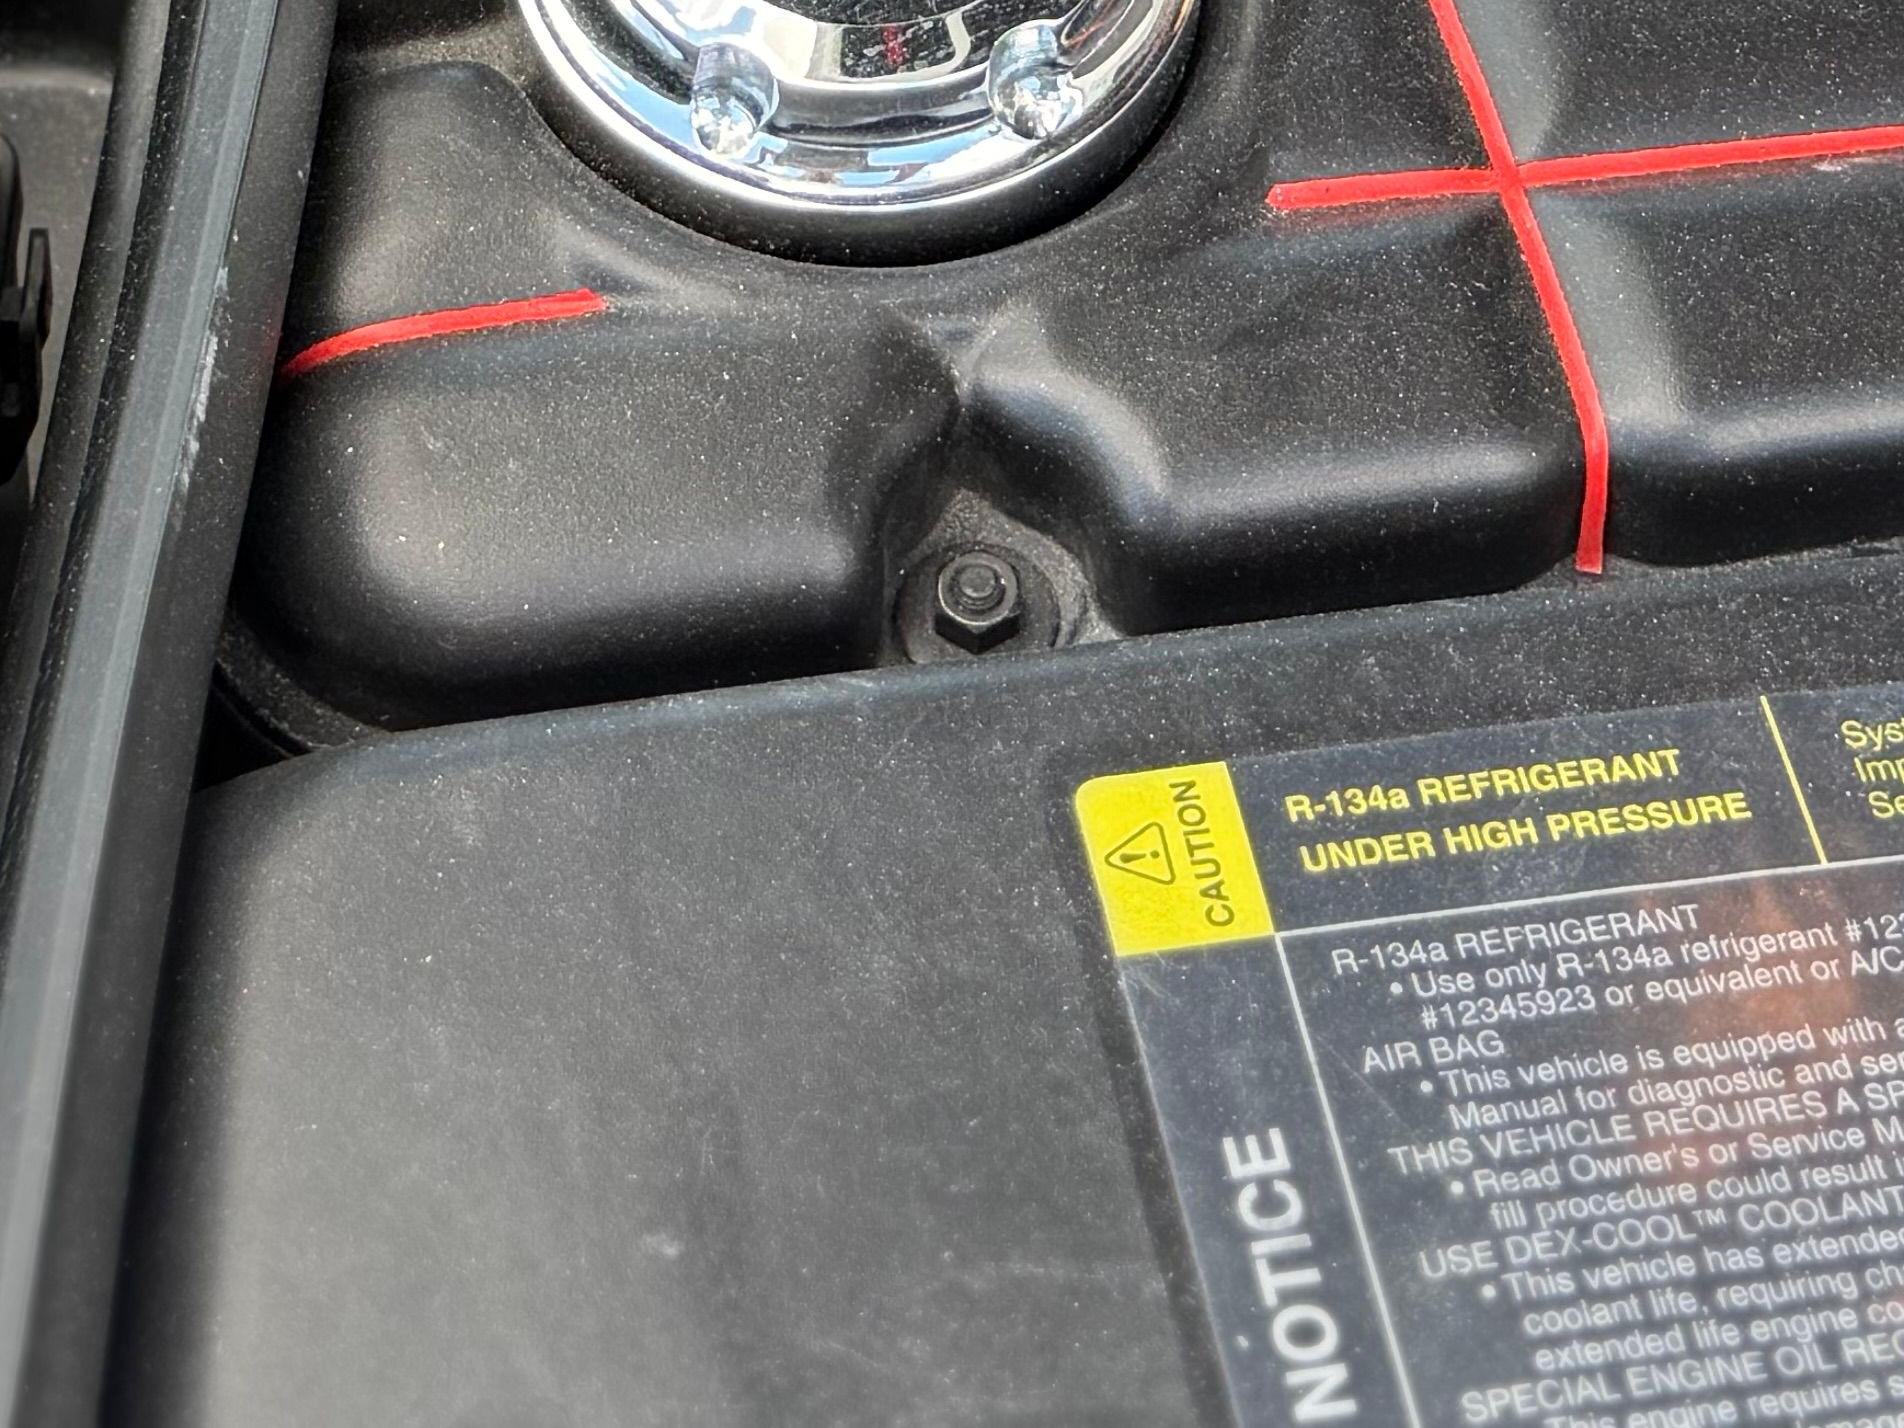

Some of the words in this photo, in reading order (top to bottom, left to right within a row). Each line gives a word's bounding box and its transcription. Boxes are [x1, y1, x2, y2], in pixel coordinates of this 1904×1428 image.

[1284, 785, 1411, 825] R-134a
[1416, 747, 1686, 806] REFRIGERANT
[1169, 779, 1235, 927] CAUTION
[1298, 831, 1437, 875] UNDER
[1440, 818, 1540, 855] HIGH
[1545, 792, 1753, 841] PRESSURE
[1327, 938, 1449, 977] R-134a
[1450, 902, 1705, 959] REFRIGERANT
[1409, 970, 1477, 998] Use
[1482, 957, 1553, 989] only
[1557, 941, 1673, 977] R-134a
[1678, 921, 1838, 962] refrigerant
[1416, 982, 1597, 1031] #12345923
[1601, 982, 1638, 1005] or
[1641, 958, 1803, 1004] equivalent
[1807, 957, 1844, 979] or
[1355, 1039, 1422, 1073] AIR
[1427, 1027, 1507, 1062] BAG
[1440, 1064, 1512, 1096] This
[1516, 1047, 1630, 1085] vehicle
[1633, 1042, 1665, 1068] is
[1669, 1021, 1816, 1068] equipped
[1821, 1013, 1887, 1044] with
[1447, 1089, 1569, 1130] Manual
[1573, 1086, 1621, 1112] for
[1623, 1062, 1786, 1105] diagnostic
[1790, 1051, 1853, 1082] and
[1389, 1138, 1475, 1175] THIS
[1481, 1114, 1636, 1160] VEHICLE
[1642, 1089, 1828, 1137] REQUIRES
[1829, 1085, 1860, 1112] A
[1472, 1162, 1563, 1200] Read
[1566, 1145, 1702, 1185] Owner's
[1706, 1143, 1742, 1165] or
[1745, 1125, 1868, 1160] Service
[1488, 1201, 1527, 1231] fill
[1535, 1181, 1699, 1230] procedure
[1703, 1163, 1791, 1198] could
[1798, 1152, 1887, 1185] result
[1222, 1126, 1358, 1424] NOTICE
[1415, 1242, 1498, 1279] USE
[1504, 1269, 1577, 1302] This
[1582, 1251, 1698, 1290] vehicle
[1701, 1244, 1765, 1271] has
